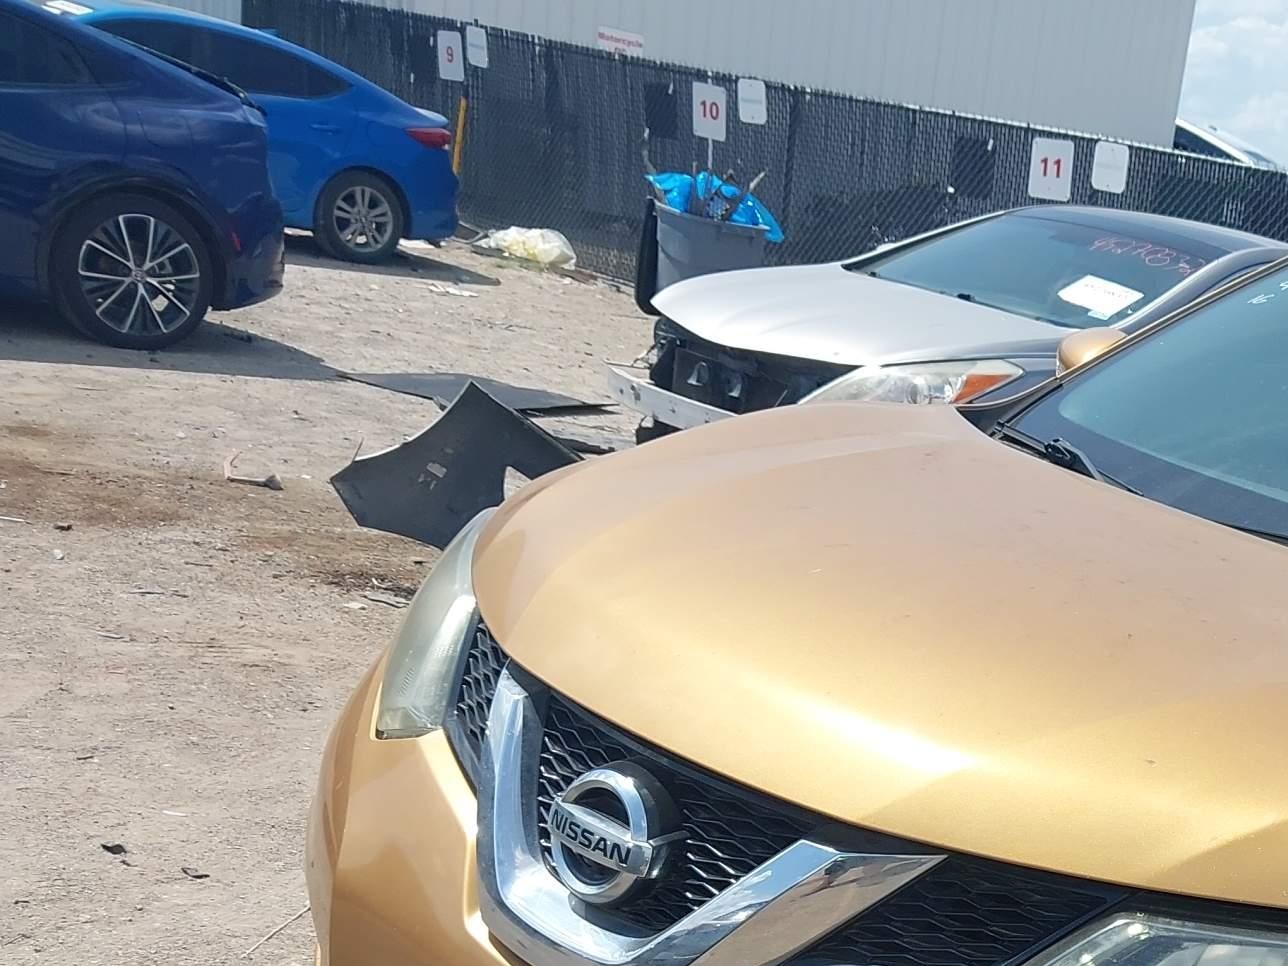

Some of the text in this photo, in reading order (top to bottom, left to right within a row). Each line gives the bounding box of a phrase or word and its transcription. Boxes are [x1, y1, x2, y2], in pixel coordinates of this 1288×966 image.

[446, 46, 454, 63] 9
[700, 99, 720, 121] 10
[1040, 157, 1062, 178] 11
[551, 808, 632, 865] NISSAN
